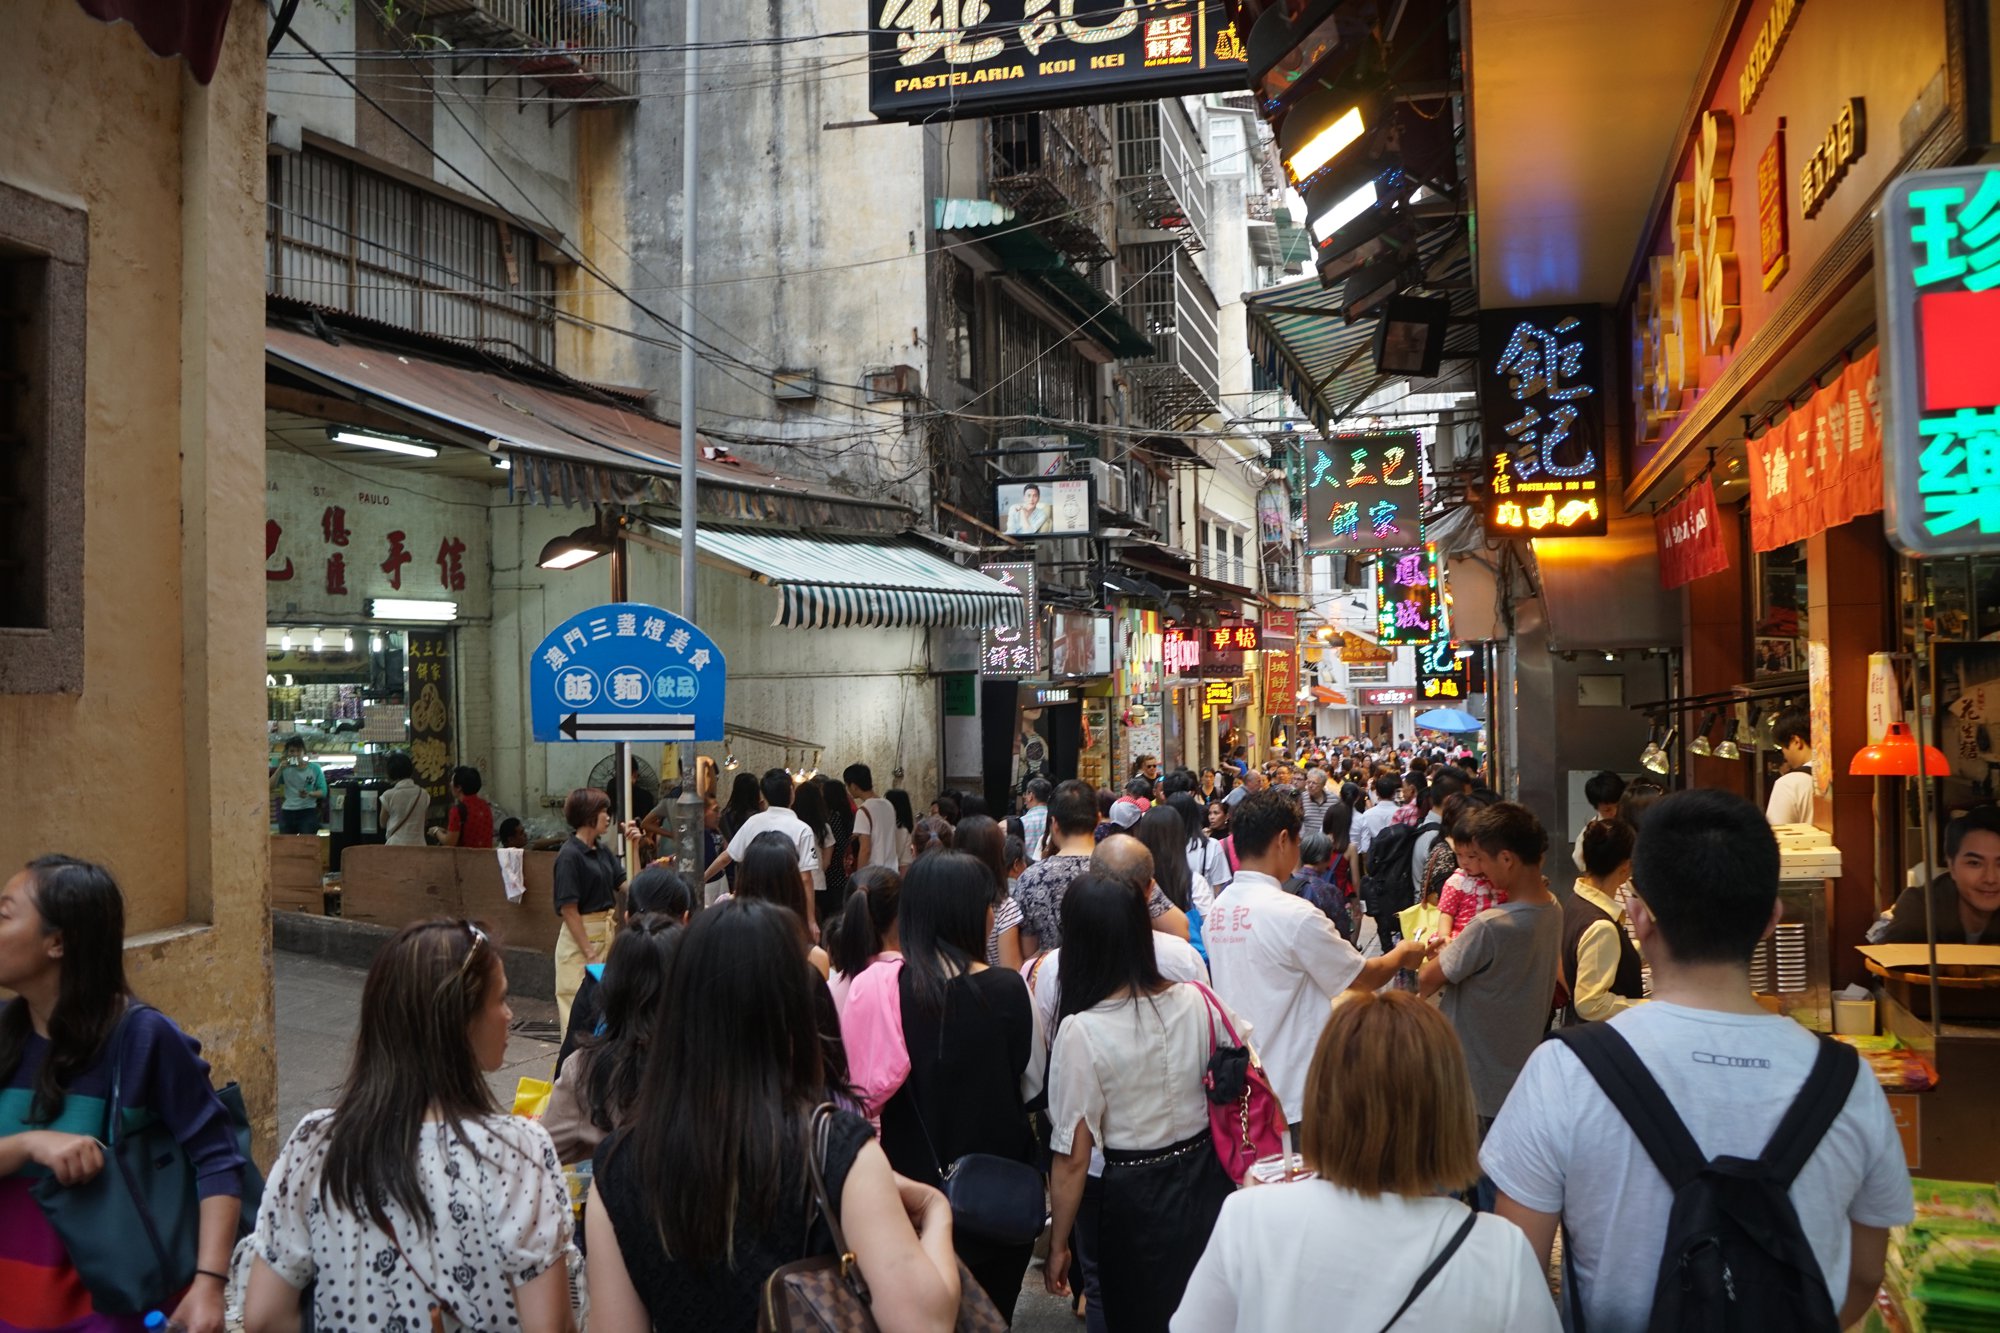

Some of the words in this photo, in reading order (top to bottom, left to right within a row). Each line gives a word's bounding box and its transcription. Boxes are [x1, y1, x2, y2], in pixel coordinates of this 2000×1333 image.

[895, 65, 1025, 92] PASTELARIA
[1039, 59, 1076, 76] KOI
[1090, 53, 1125, 70] KEI
[1309, 446, 1414, 488] 大三巴
[1493, 452, 1511, 494] 手信
[359, 492, 390, 505] PAULO
[1330, 500, 1399, 540] 餅家
[1394, 555, 1430, 631] 鳳城
[543, 613, 711, 672] 澳門三盞燈美食
[1213, 628, 1256, 650] 卓悅
[563, 673, 593, 701] 飯
[613, 672, 643, 701] 麵
[656, 675, 696, 699] 飲品
[1209, 905, 1252, 931] 鉅記
